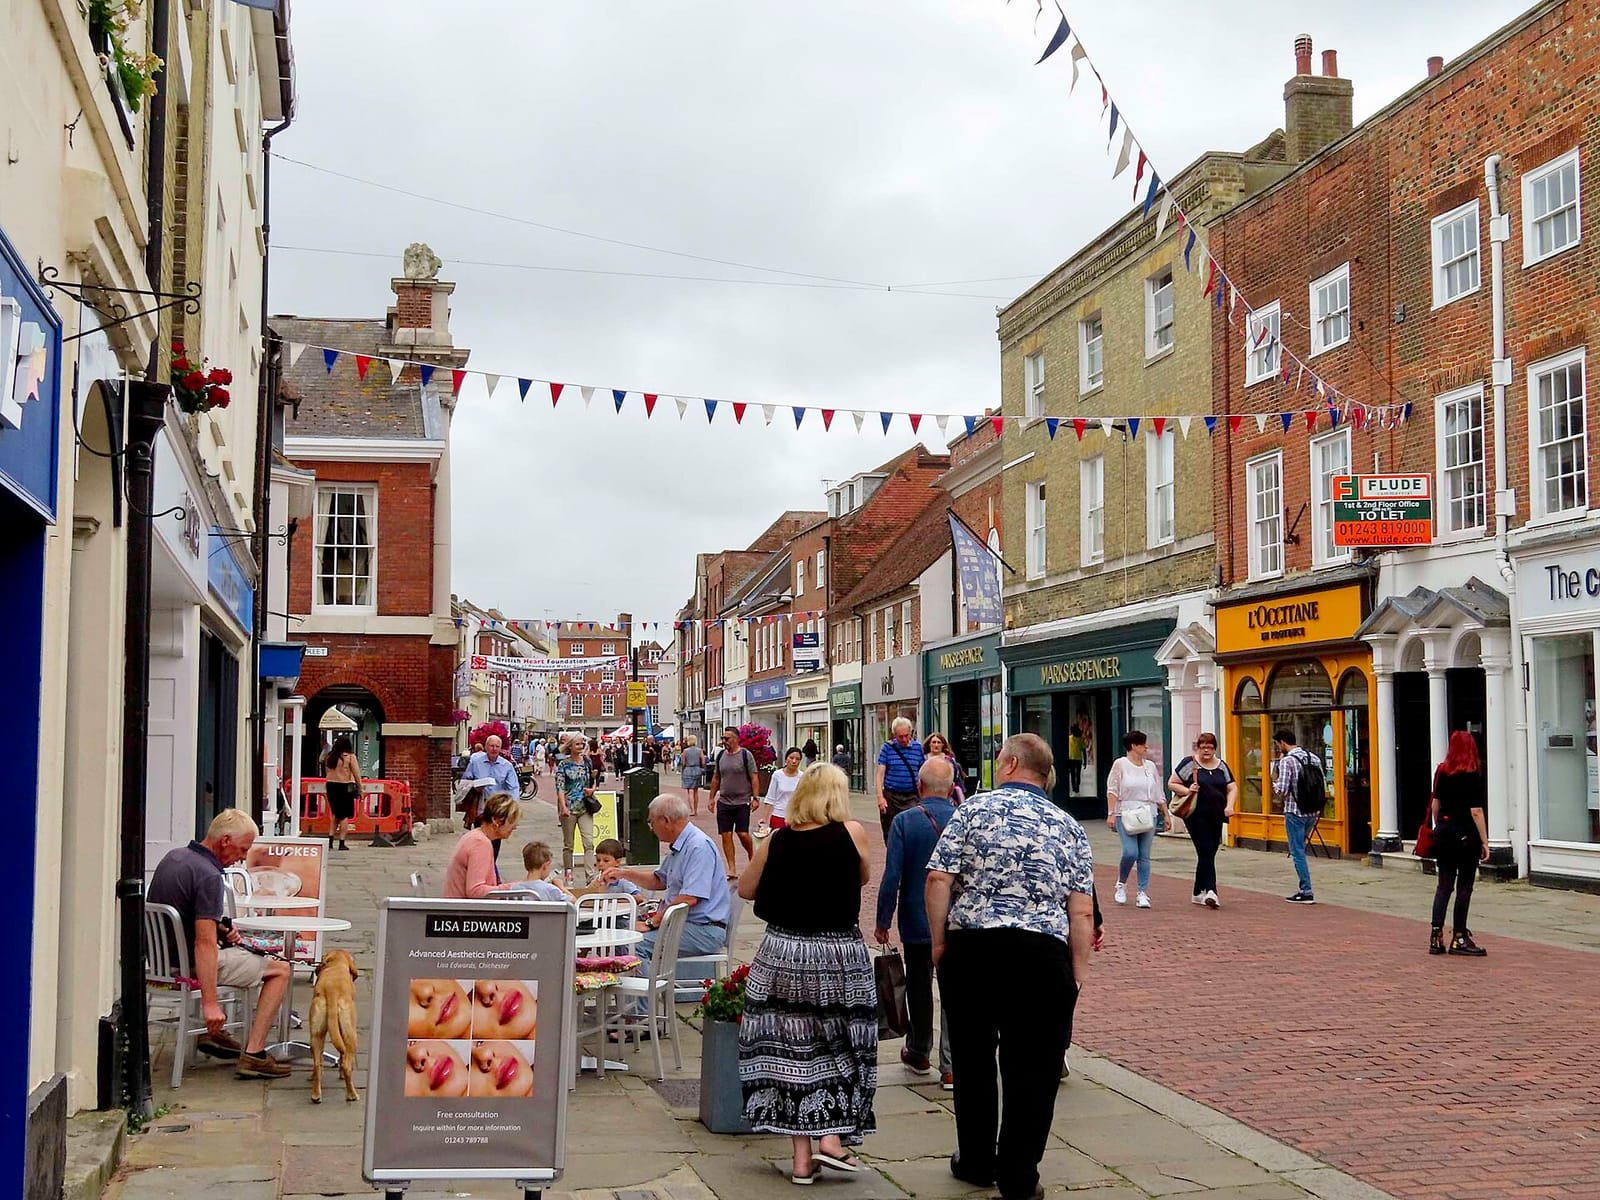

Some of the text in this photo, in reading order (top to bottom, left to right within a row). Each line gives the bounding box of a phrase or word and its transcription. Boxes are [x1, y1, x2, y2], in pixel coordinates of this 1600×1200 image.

[1368, 479, 1421, 490] FLUDE
[1398, 500, 1420, 508] Office
[1358, 511, 1377, 520] TO
[1380, 510, 1406, 520] LET
[1340, 521, 1425, 535] 01243 819000
[1344, 534, 1423, 544] www.flude.com
[1544, 564, 1600, 601] The c
[546, 657, 588, 665] Foundation
[268, 846, 319, 857] LUCKES
[433, 920, 522, 933] LISA EDWARDS
[408, 950, 446, 959] Advanced
[447, 950, 485, 960] Aesthetics
[486, 951, 530, 960] Practitioner
[437, 961, 511, 970] Lisa Edwards, Chichester
[436, 1110, 499, 1119] Free consultation
[412, 1124, 435, 1132] Inquire
[436, 1124, 456, 1132] within
[456, 1124, 467, 1132] for
[484, 1124, 521, 1132] information
